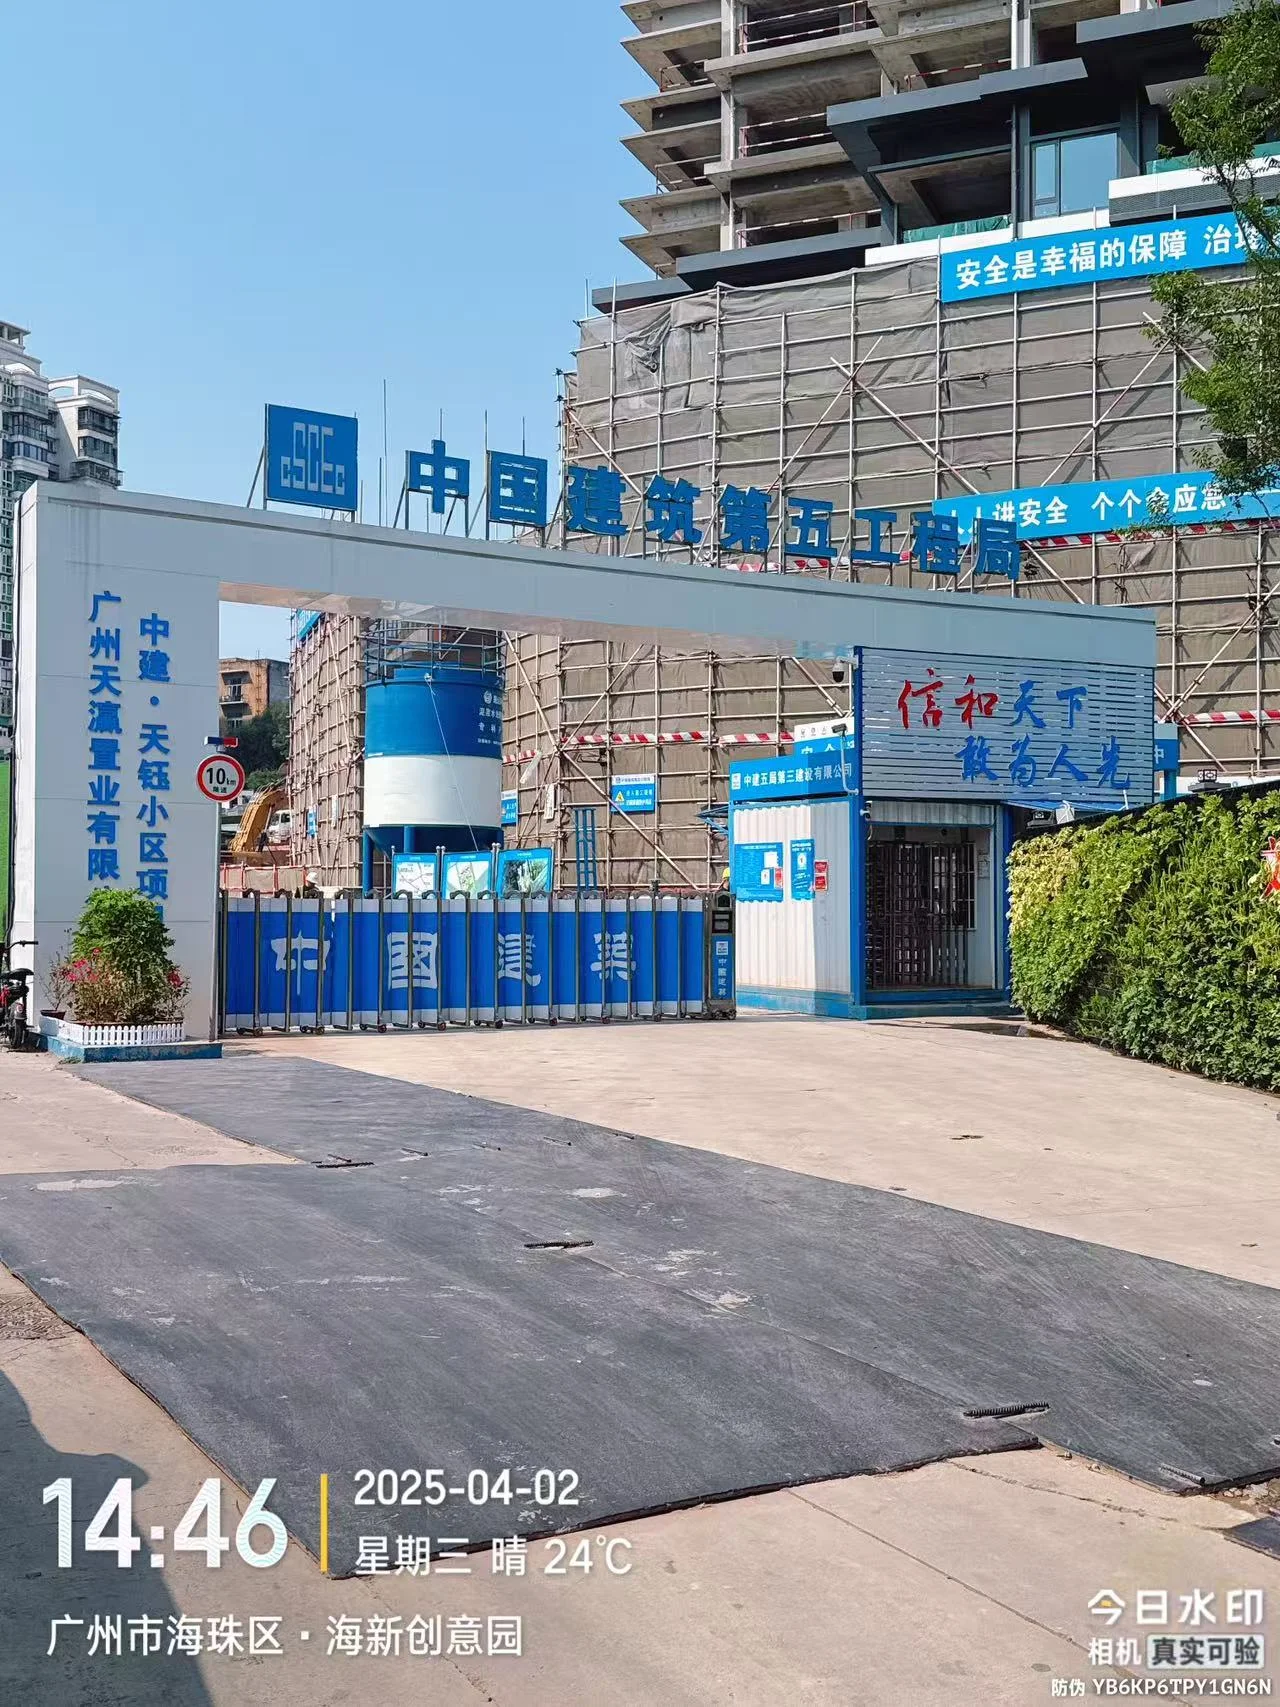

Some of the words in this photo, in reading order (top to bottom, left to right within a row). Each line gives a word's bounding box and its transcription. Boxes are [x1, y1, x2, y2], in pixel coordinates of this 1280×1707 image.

[956, 230, 1186, 290] 安全是幸福的保障
[405, 439, 1020, 579] 中国建筑第五工程局
[88, 591, 122, 904] 广州天瀛置业有限
[897, 667, 1088, 729] 信和天下
[136, 613, 171, 924] 中建·天钰小区项
[954, 733, 1131, 788] 敢为人先
